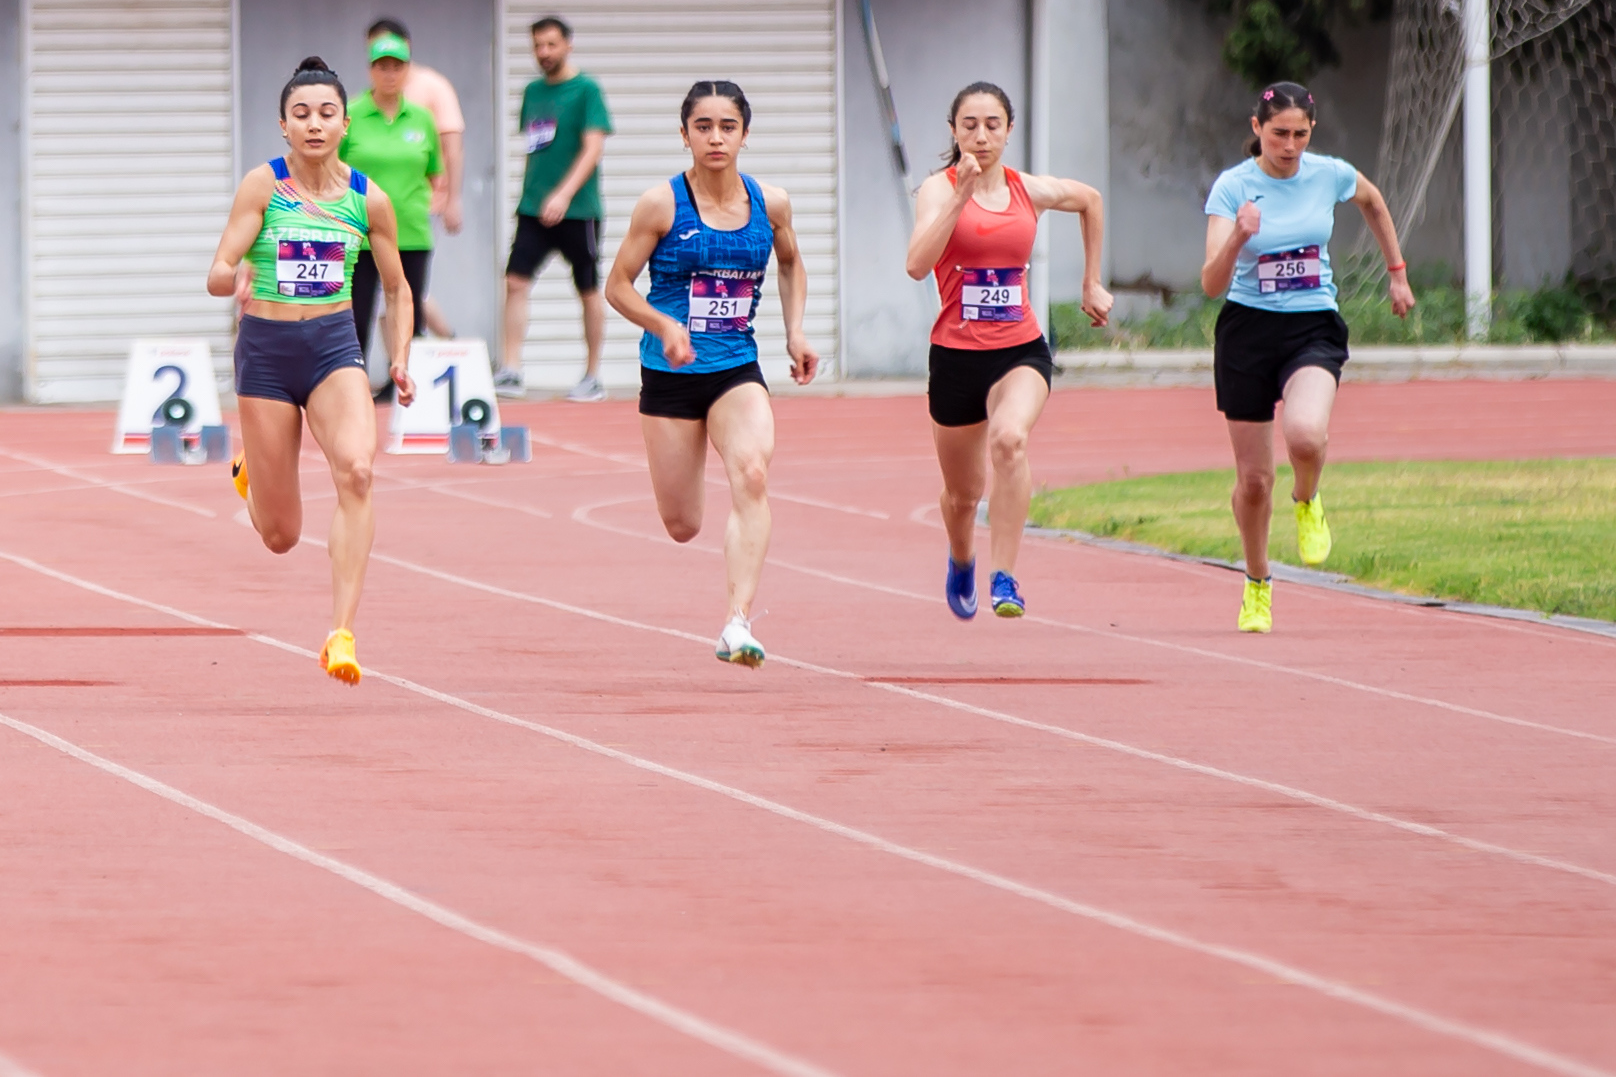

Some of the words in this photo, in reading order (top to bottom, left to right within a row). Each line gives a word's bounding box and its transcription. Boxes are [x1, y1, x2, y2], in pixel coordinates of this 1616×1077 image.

[296, 263, 329, 280] 247
[1275, 261, 1306, 277] 256
[980, 289, 1010, 304] 249
[708, 300, 738, 316] 251
[151, 365, 189, 425] 2
[432, 365, 462, 426] 1
